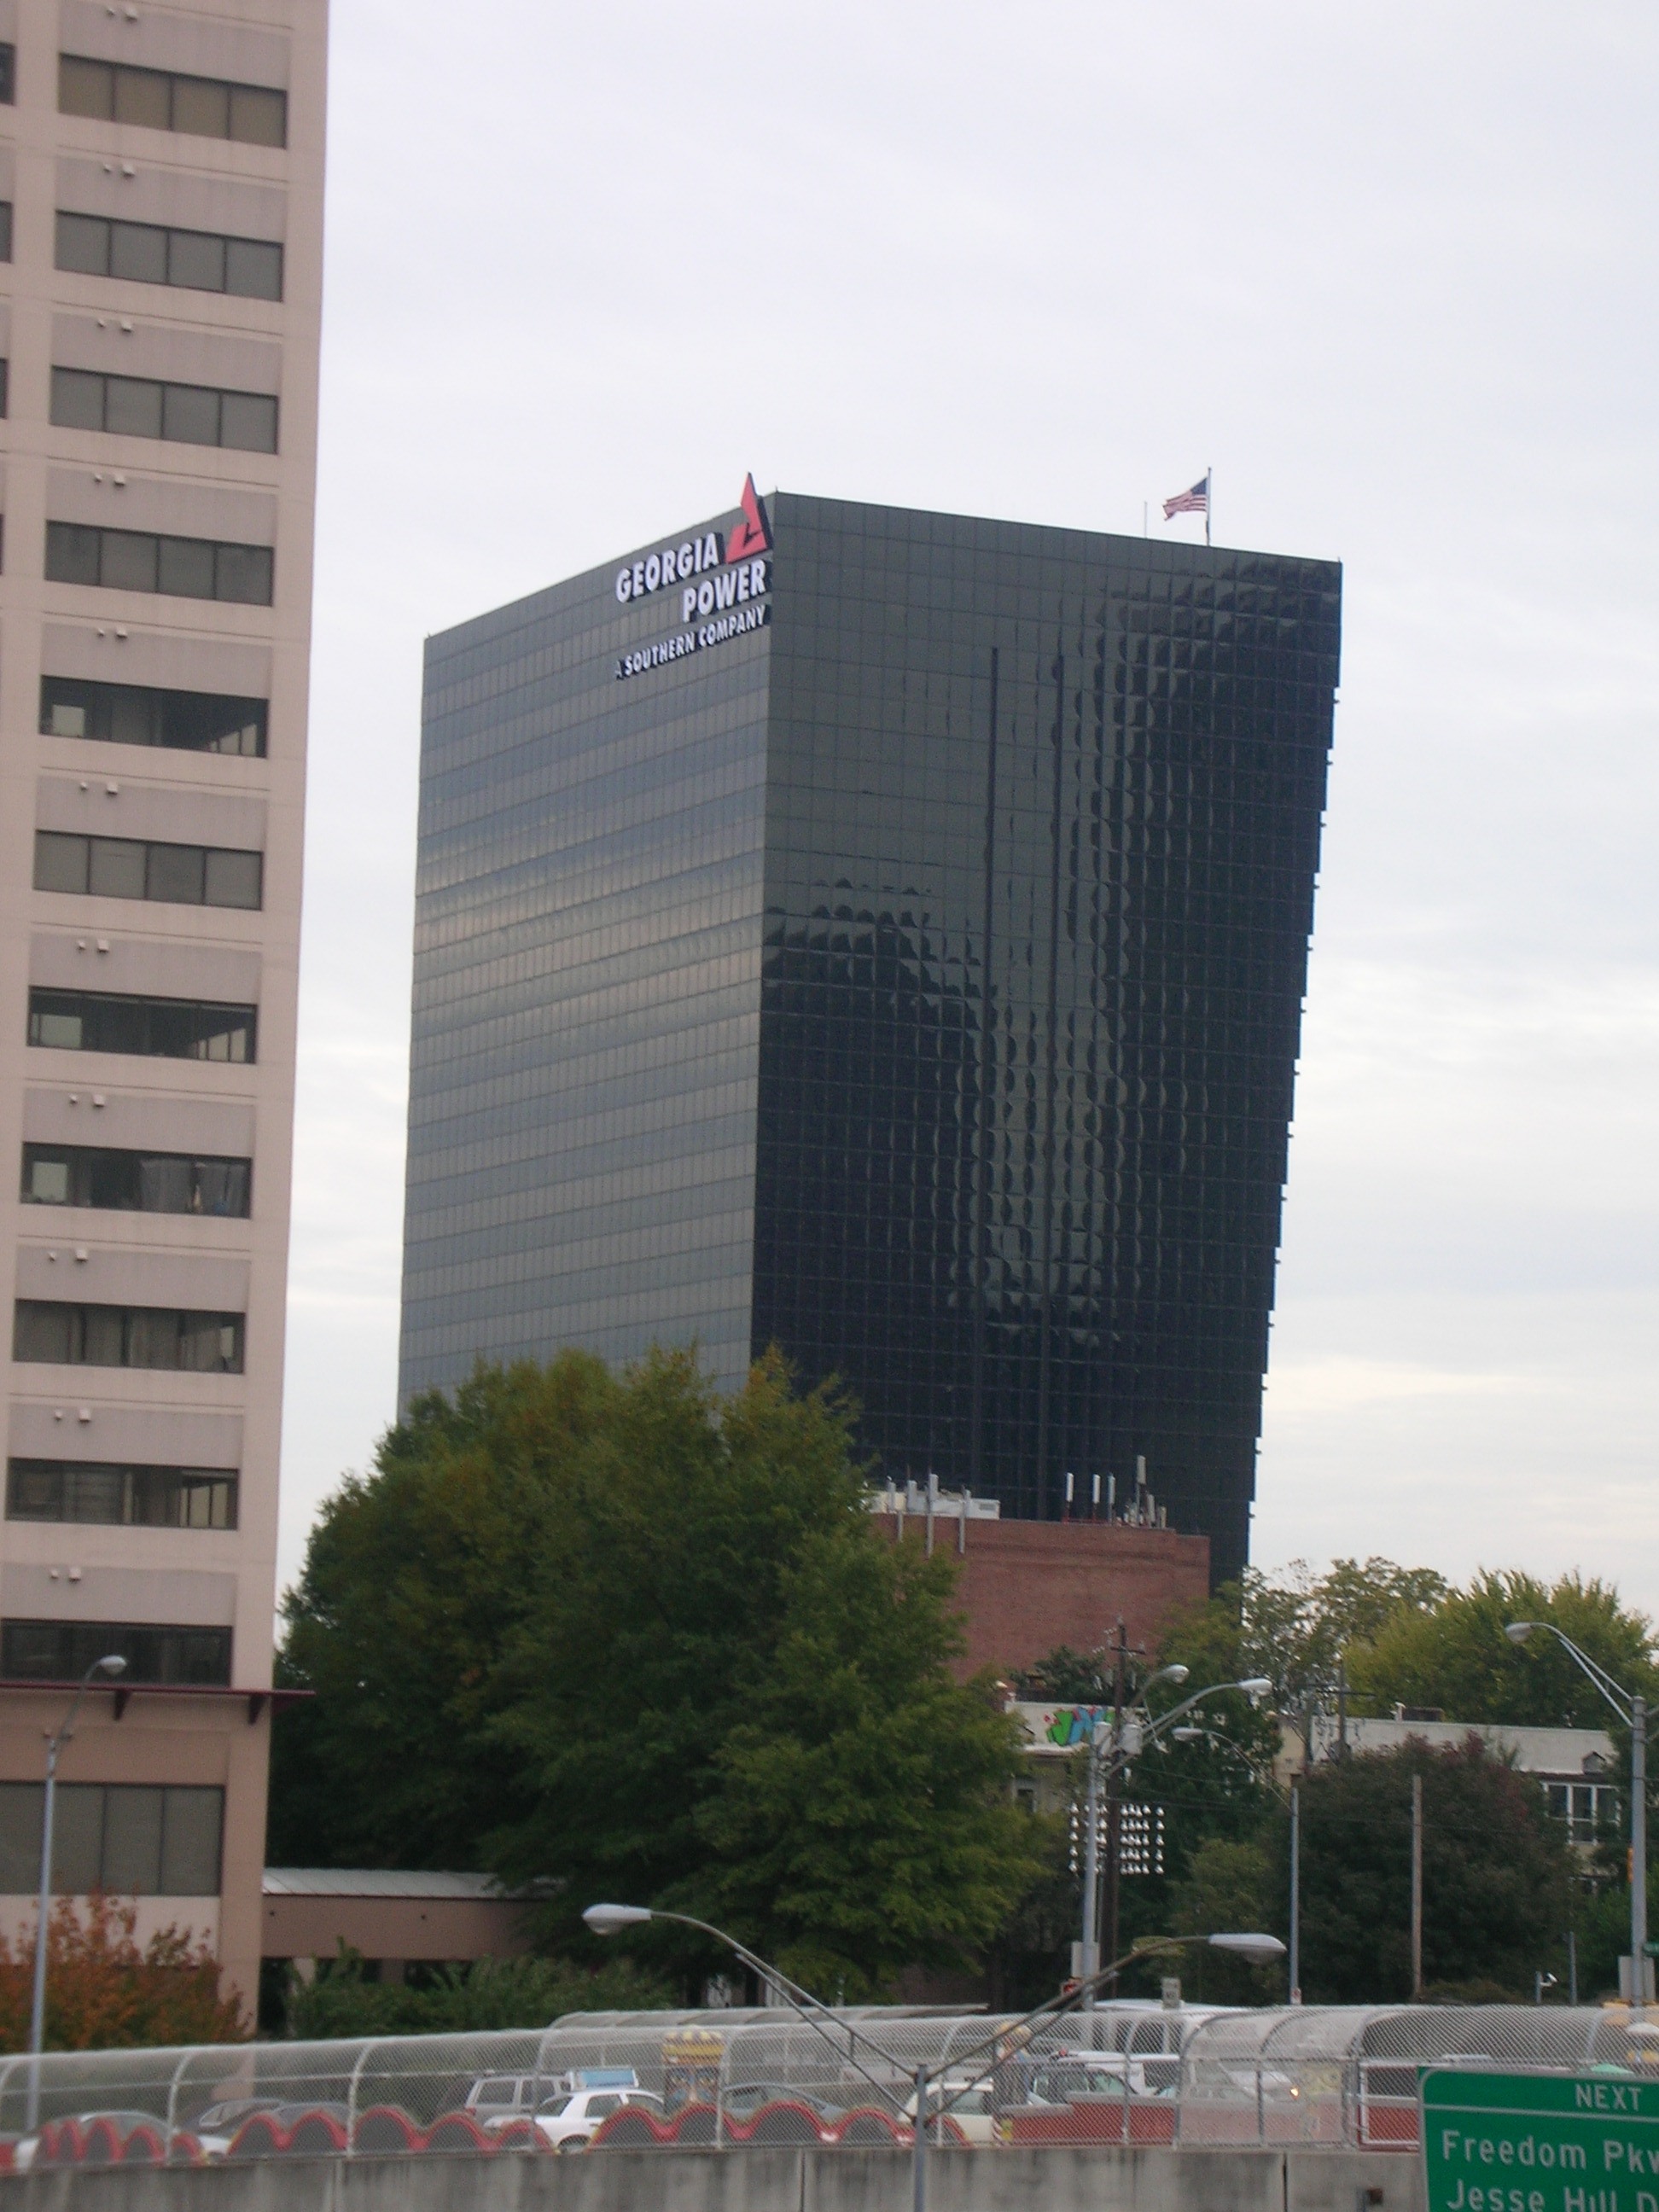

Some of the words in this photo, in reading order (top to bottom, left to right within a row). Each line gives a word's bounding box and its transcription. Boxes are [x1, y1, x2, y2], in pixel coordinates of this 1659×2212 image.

[616, 533, 719, 603] GEORGIA
[684, 559, 766, 623] POWER
[625, 632, 696, 677] SOUTHERN
[699, 605, 766, 648] COMPANY
[1575, 2083, 1642, 2111] NEXT
[1442, 2129, 1587, 2170] Freedom
[1447, 2179, 1545, 2212] Jesse
[1563, 2186, 1618, 2212] Hill
